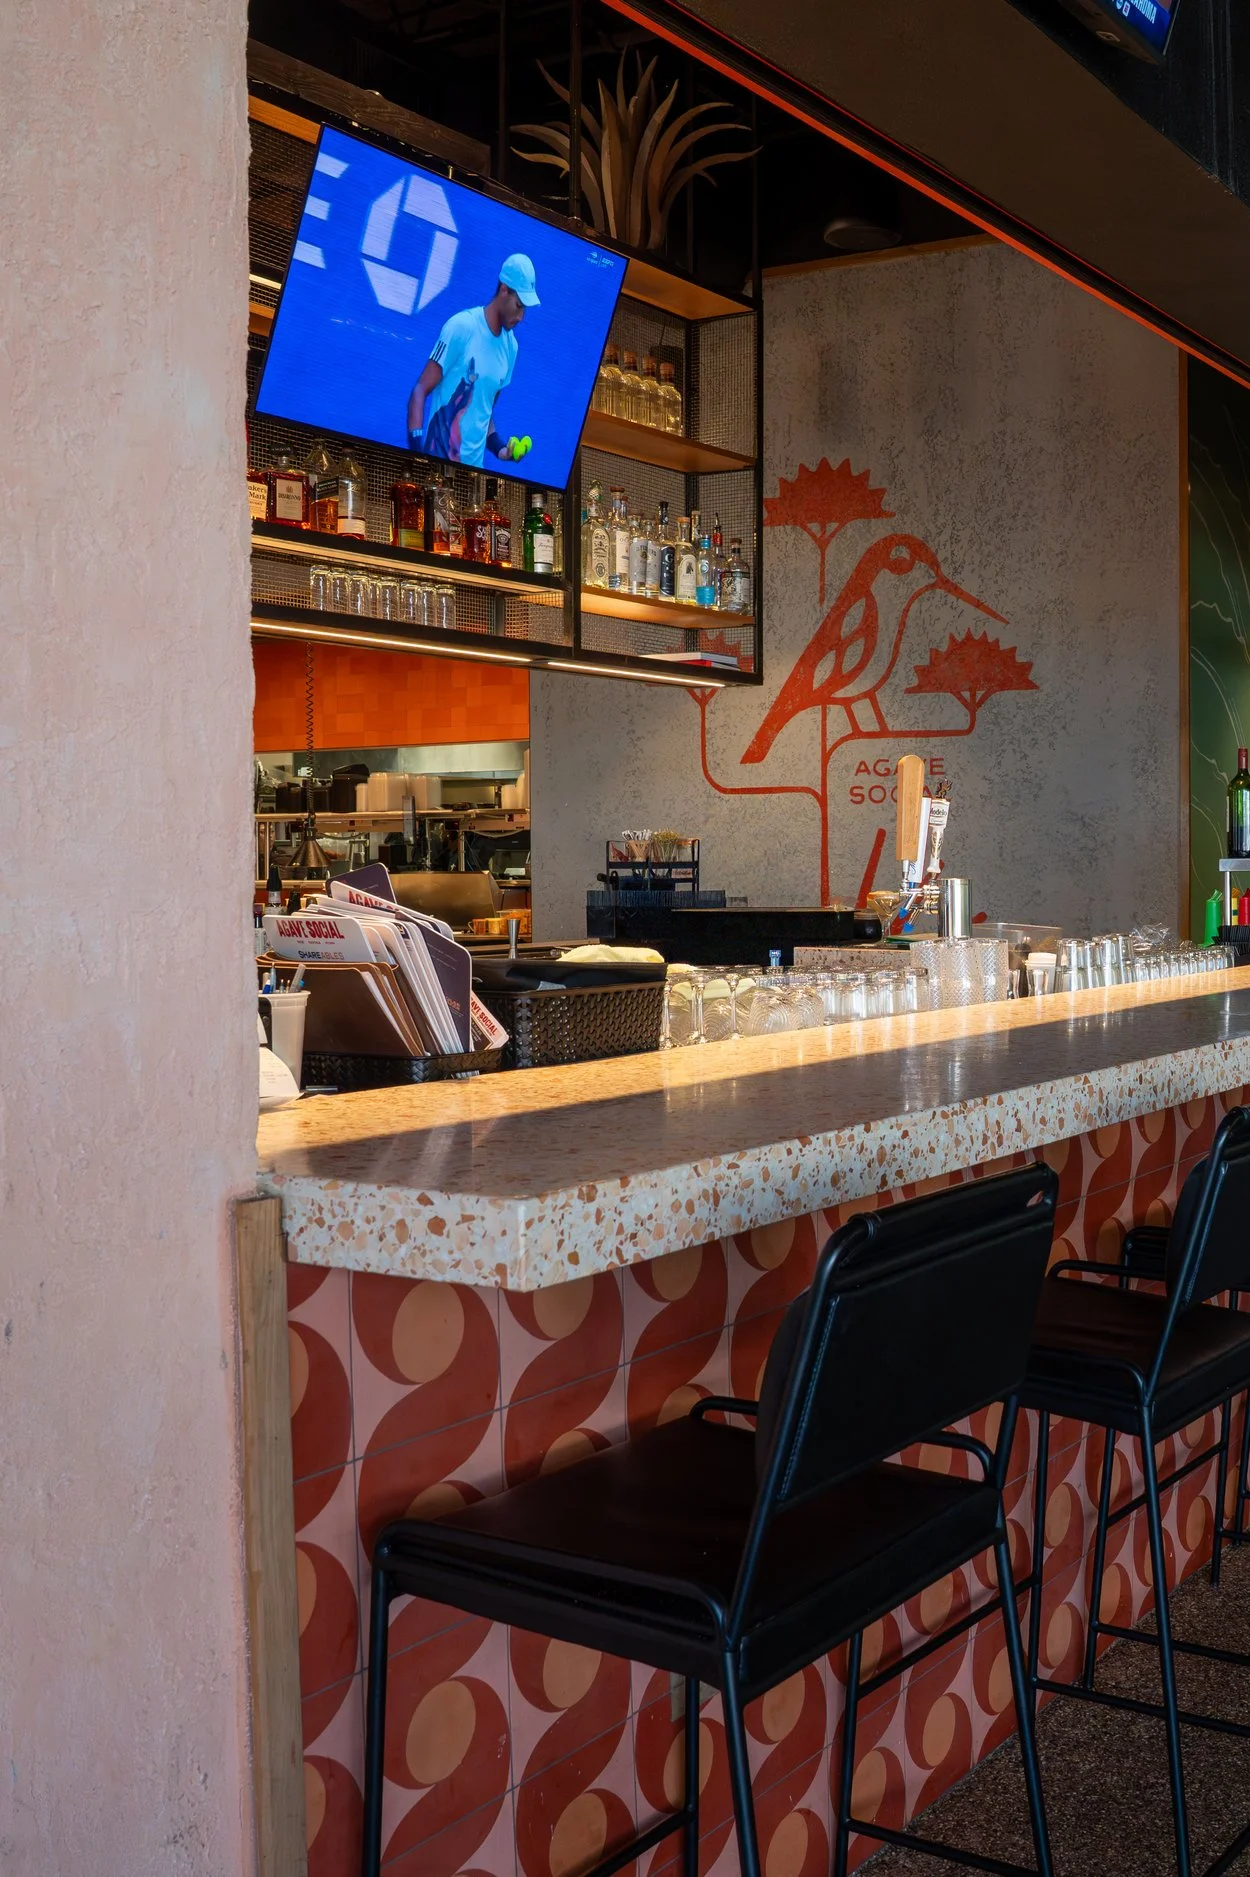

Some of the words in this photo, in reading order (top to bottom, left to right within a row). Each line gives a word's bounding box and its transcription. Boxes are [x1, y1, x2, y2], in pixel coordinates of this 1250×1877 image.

[854, 757, 945, 777] AGE
[276, 919, 308, 938] AGAVE
[305, 920, 345, 939] SOCIAL
[298, 950, 345, 960] SHAREABLES
[479, 1012, 498, 1036] SOCIAL
